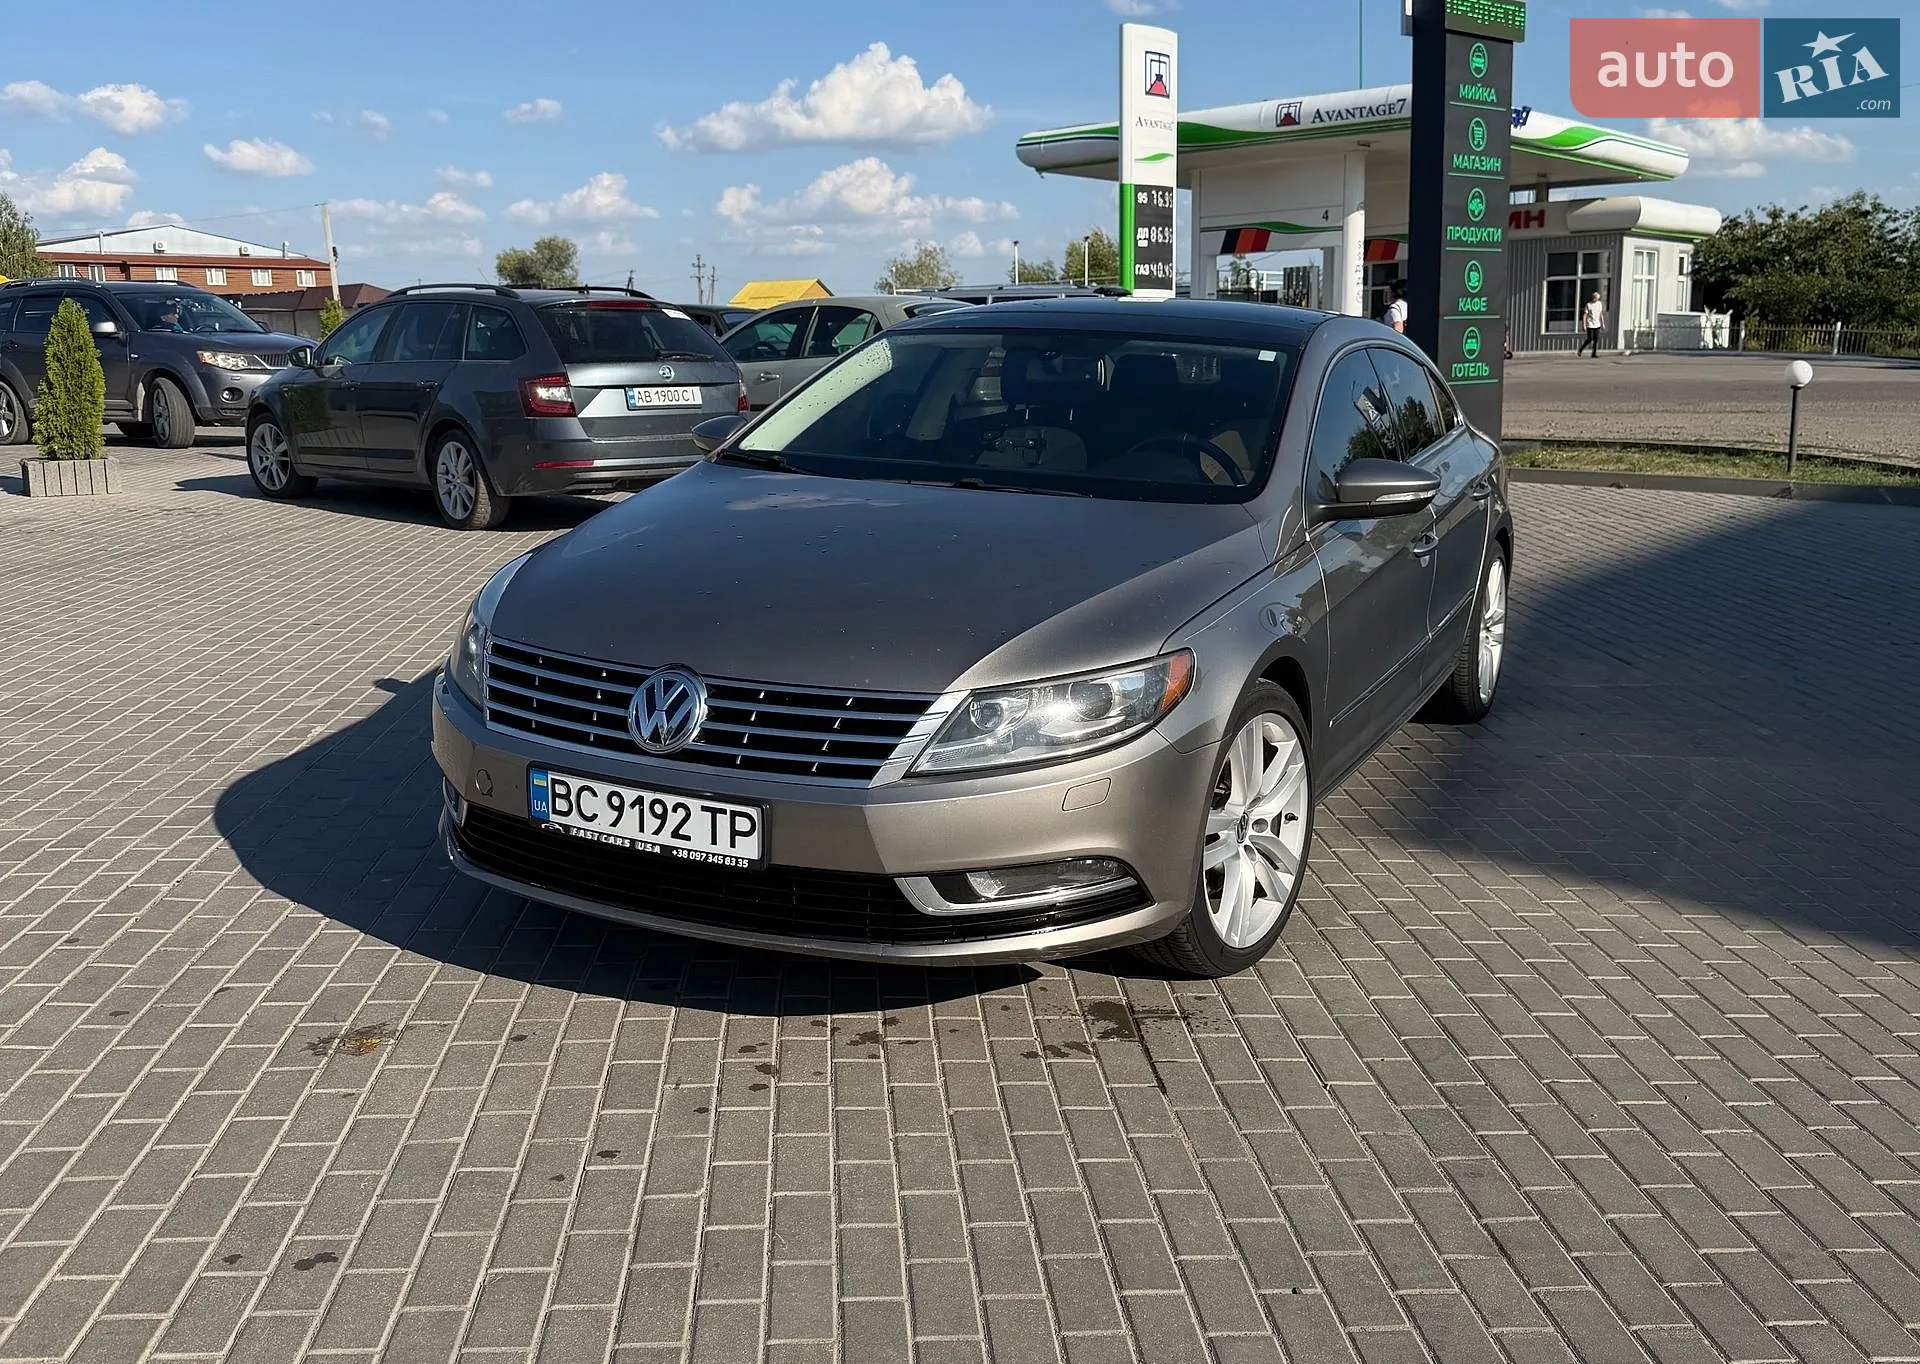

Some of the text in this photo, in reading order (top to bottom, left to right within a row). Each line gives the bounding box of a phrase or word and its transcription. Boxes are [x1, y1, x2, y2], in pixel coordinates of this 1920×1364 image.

[1459, 83, 1497, 103] МИЙКА
[1453, 154, 1502, 172] МАГАЗИН
[1322, 210, 1329, 222] 4
[1447, 226, 1502, 243] ПРОДУКТИ
[1458, 297, 1488, 312] КАФЕ
[1451, 362, 1490, 378] ГОТЕЛЬ
[654, 389, 680, 403] 1900
[533, 800, 548, 813] UA
[550, 777, 757, 849] BC 9192 TP
[570, 827, 749, 869] FAST CARS USA +38 097 345 83 35
